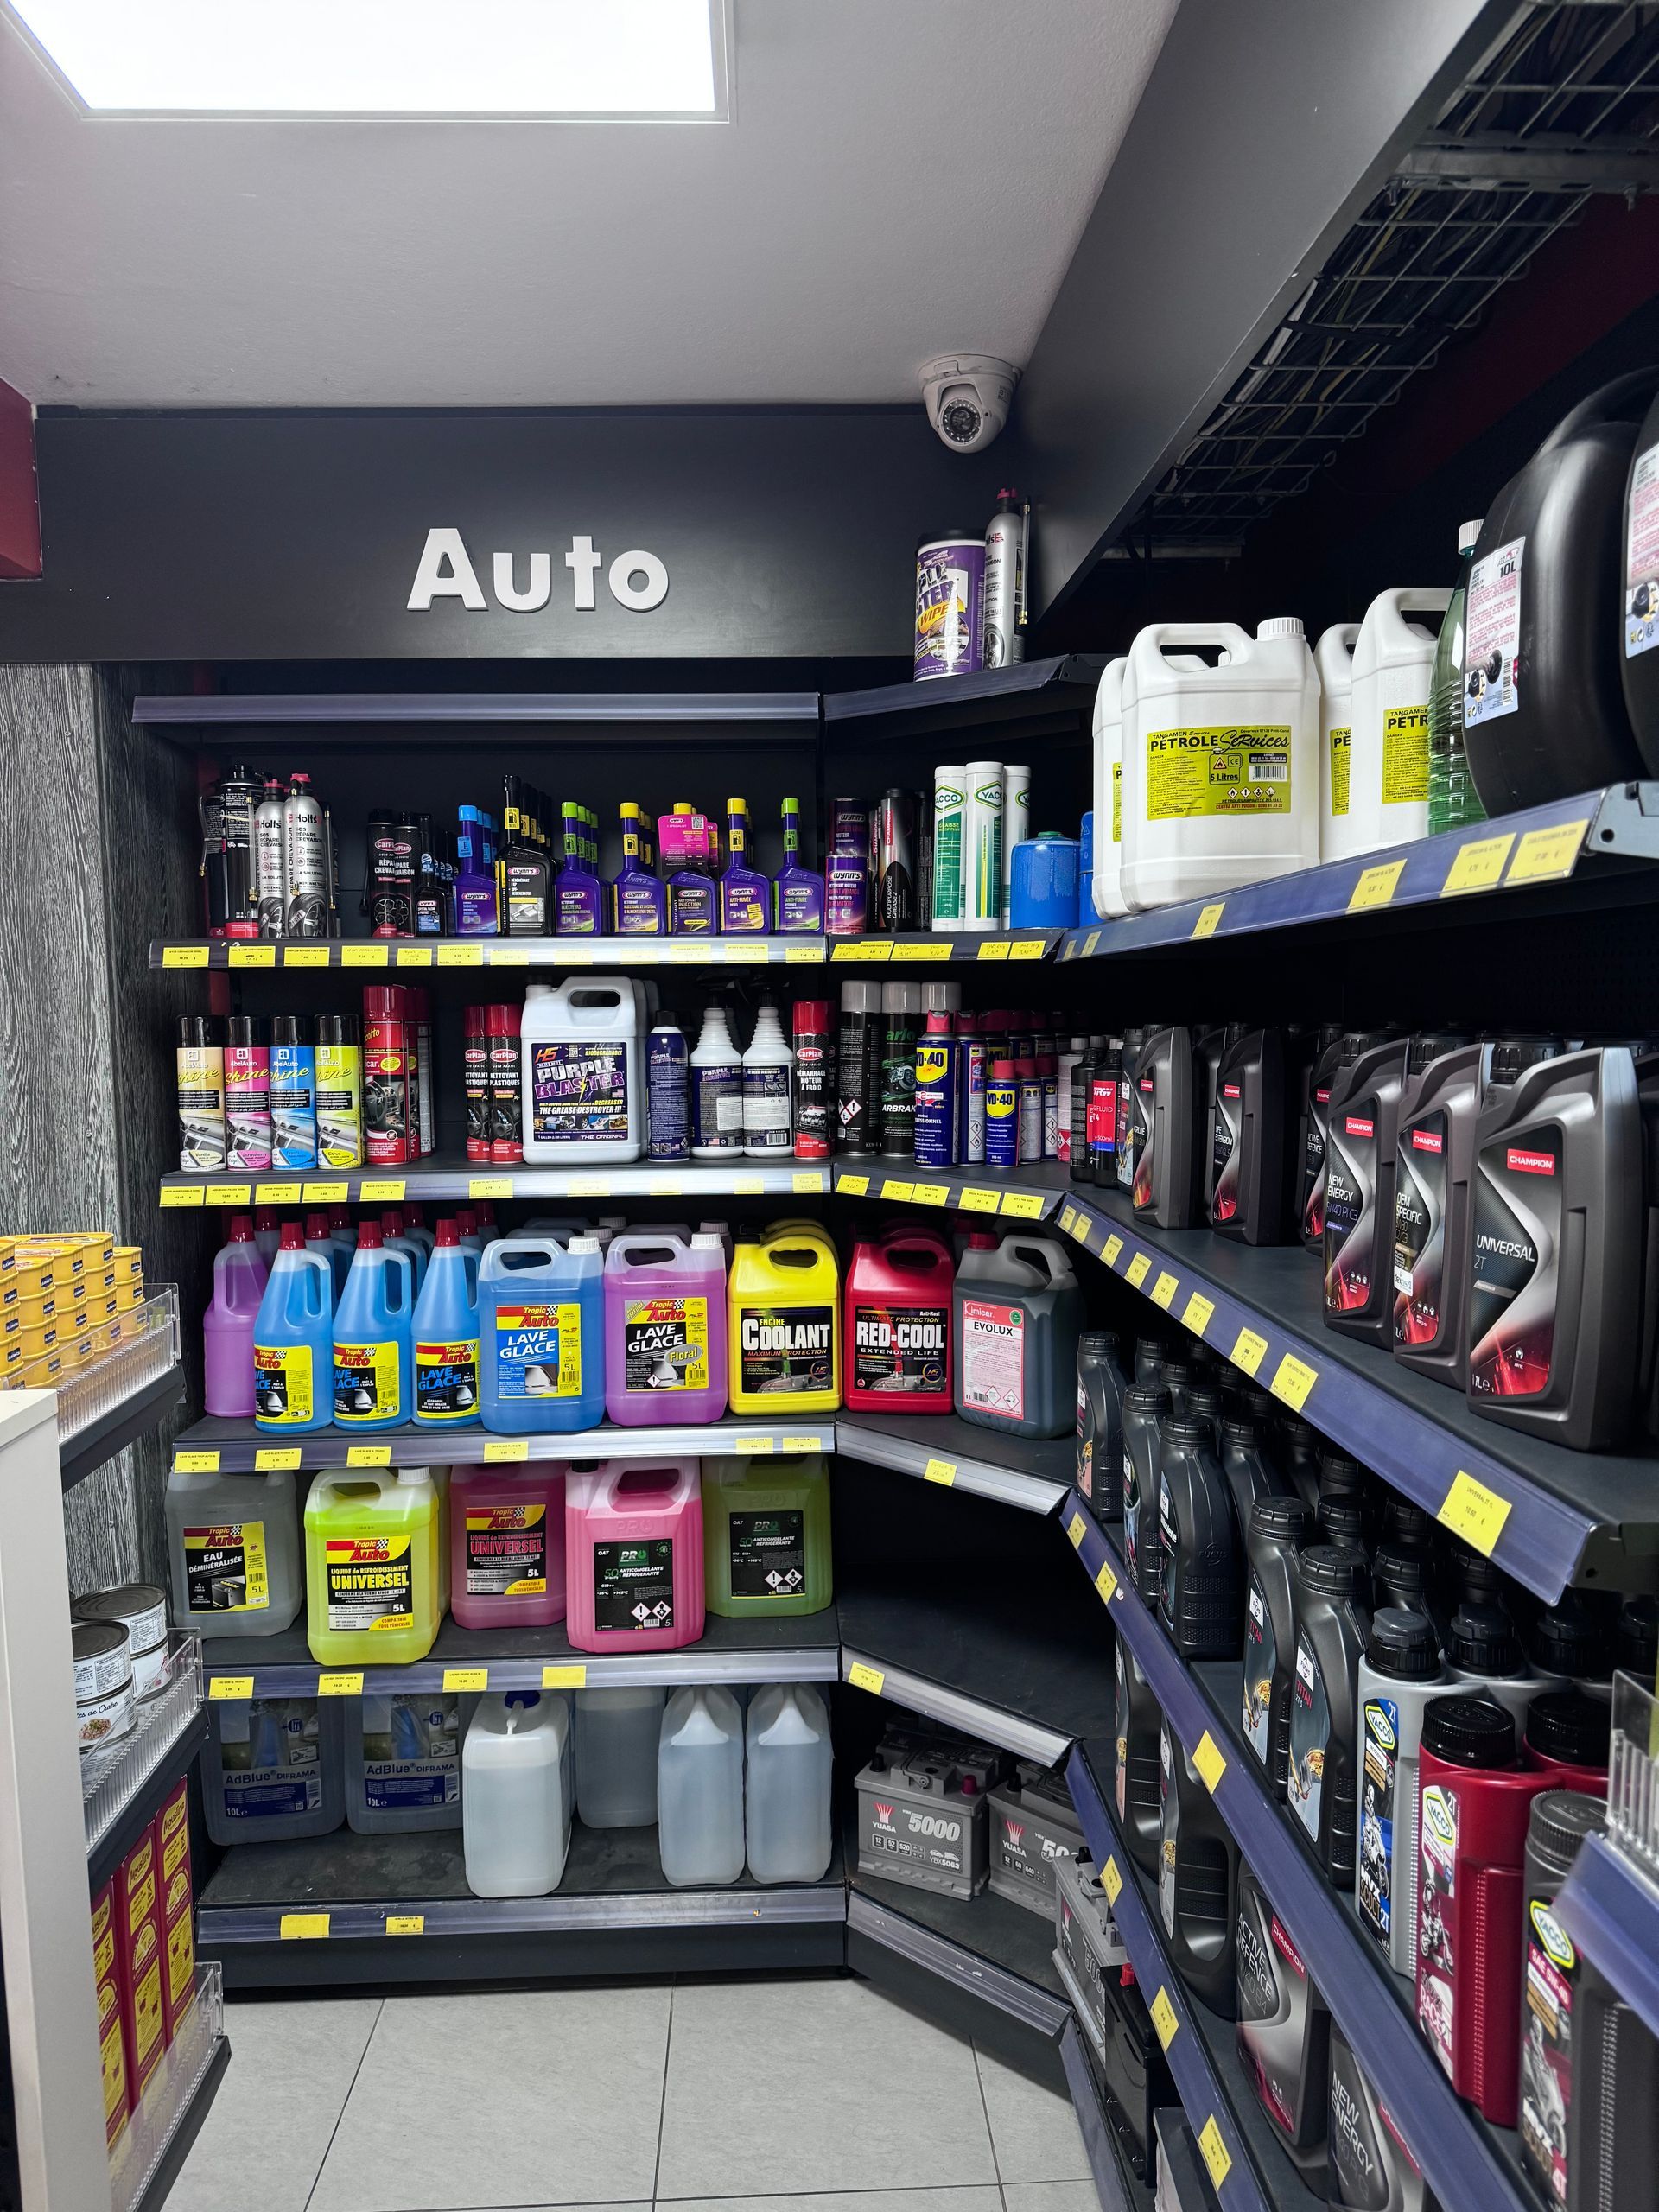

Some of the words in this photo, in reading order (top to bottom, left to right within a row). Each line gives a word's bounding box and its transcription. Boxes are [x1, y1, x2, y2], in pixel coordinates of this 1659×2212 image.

[406, 527, 670, 613] Auto
[1500, 561, 1517, 579] 10L
[1217, 772, 1239, 781] Litres
[296, 814, 317, 823] Holts
[917, 1051, 945, 1069] D-40
[537, 1057, 617, 1084] PURPLE
[534, 1071, 626, 1100] BLASTER
[1093, 1087, 1114, 1096] TRW
[1347, 1122, 1373, 1132] CHAMPION
[1413, 1136, 1441, 1148] CHAMPION
[1510, 1154, 1554, 1169] CHAMPION
[1328, 1174, 1344, 1186] NEW
[1327, 1185, 1355, 1203] ENERGY
[1397, 1192, 1412, 1209] OEM
[1395, 1205, 1423, 1225] SPECIFIC
[1476, 1234, 1535, 1262] UNIVERSAL
[1473, 1255, 1486, 1269] 2T
[651, 1300, 674, 1308] Tropic
[518, 1314, 560, 1328] Auto
[646, 1307, 687, 1322] Auto
[759, 1318, 785, 1327] ENGINE
[973, 1321, 1014, 1337] EVOLUX
[507, 1330, 549, 1346] LAVE
[635, 1324, 677, 1340] LAVE
[742, 1319, 831, 1351] COOLANT
[856, 1320, 944, 1349] RED-COOL
[445, 1344, 466, 1353] Tropic
[499, 1340, 556, 1359] GLACE
[627, 1333, 684, 1353] GLACE
[340, 1355, 371, 1367] Auto
[437, 1351, 473, 1365] Auto
[669, 1346, 698, 1363] Floral
[256, 1357, 282, 1369] Auto
[334, 1369, 353, 1379] AVE
[421, 1366, 454, 1381] LAVE
[417, 1373, 462, 1390] GLACE
[493, 1508, 515, 1516] Tropic
[487, 1516, 527, 1529] Auto
[204, 1535, 245, 1548] Auto
[353, 1540, 377, 1548] Tropic
[470, 1538, 544, 1556] UNIVERSEL
[203, 1551, 224, 1563] EAU
[349, 1548, 391, 1561] Auto
[188, 1555, 244, 1573] DÉMINÉRALISÉE
[359, 1564, 410, 1574] REFROIDISSEMENT
[527, 1568, 540, 1578] 5L
[621, 1570, 661, 1579] REFRIGERANTE
[331, 1572, 410, 1590] UNIVERSEL
[392, 1603, 406, 1613] 5L
[1296, 1678, 1313, 1710] TITAN
[1370, 1709, 1392, 1743] YACCO
[276, 1770, 316, 1780] DIFRAMA
[416, 1763, 455, 1773] DIFRAMA
[367, 1797, 381, 1807] 10L
[1429, 1801, 1450, 1836] YACCO
[872, 1821, 897, 1834] YUASA
[907, 1812, 962, 1842] 5000
[1002, 1840, 1027, 1858] YUASA
[929, 1856, 961, 1870] YBX5063
[1536, 1909, 1568, 1958] YACCO
[1272, 1923, 1306, 1974] CHAMPION
[1236, 1925, 1281, 2003] DEFENCE
[1332, 2069, 1360, 2126] NEW
[1332, 2088, 1374, 2177] ENERGY
